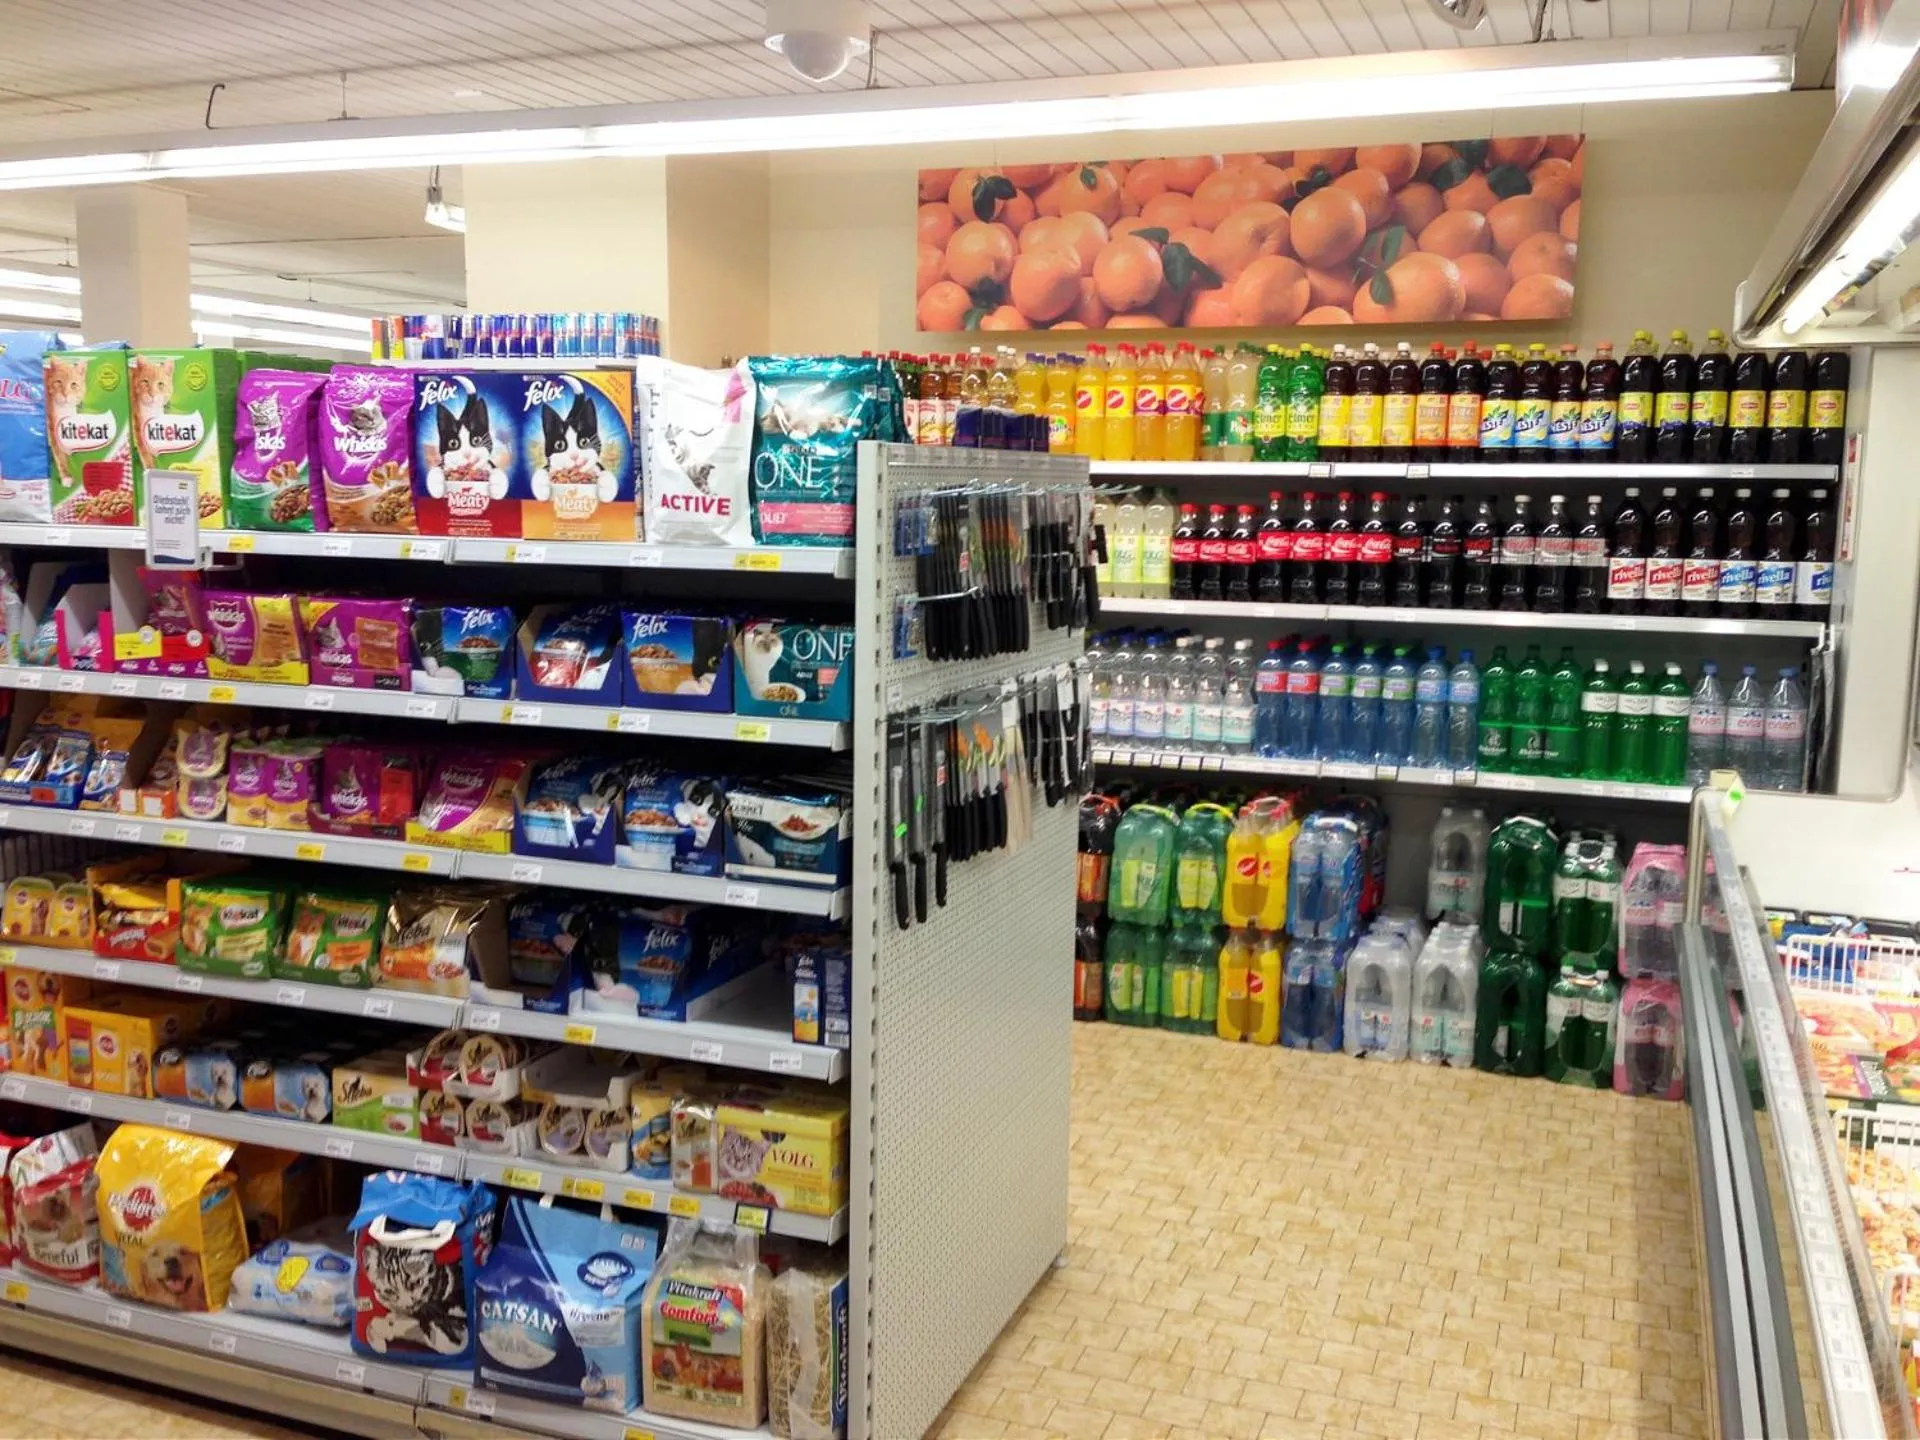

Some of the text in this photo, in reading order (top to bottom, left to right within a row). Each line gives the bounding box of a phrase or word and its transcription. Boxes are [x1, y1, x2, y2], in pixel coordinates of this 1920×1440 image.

[419, 380, 457, 411] felix
[524, 380, 565, 411] felix
[61, 422, 109, 440] kitekat
[148, 422, 196, 441] kitekat
[755, 452, 824, 488] ONE
[448, 491, 489, 509] Meaty
[660, 492, 731, 516] ACTIVE
[1721, 567, 1755, 583] rivella
[1758, 566, 1791, 584] rivella
[460, 608, 495, 634] felix
[632, 614, 669, 643] felix
[644, 927, 679, 953] felix
[481, 1299, 558, 1335] CATSAN
[660, 1301, 719, 1325] Comfort
